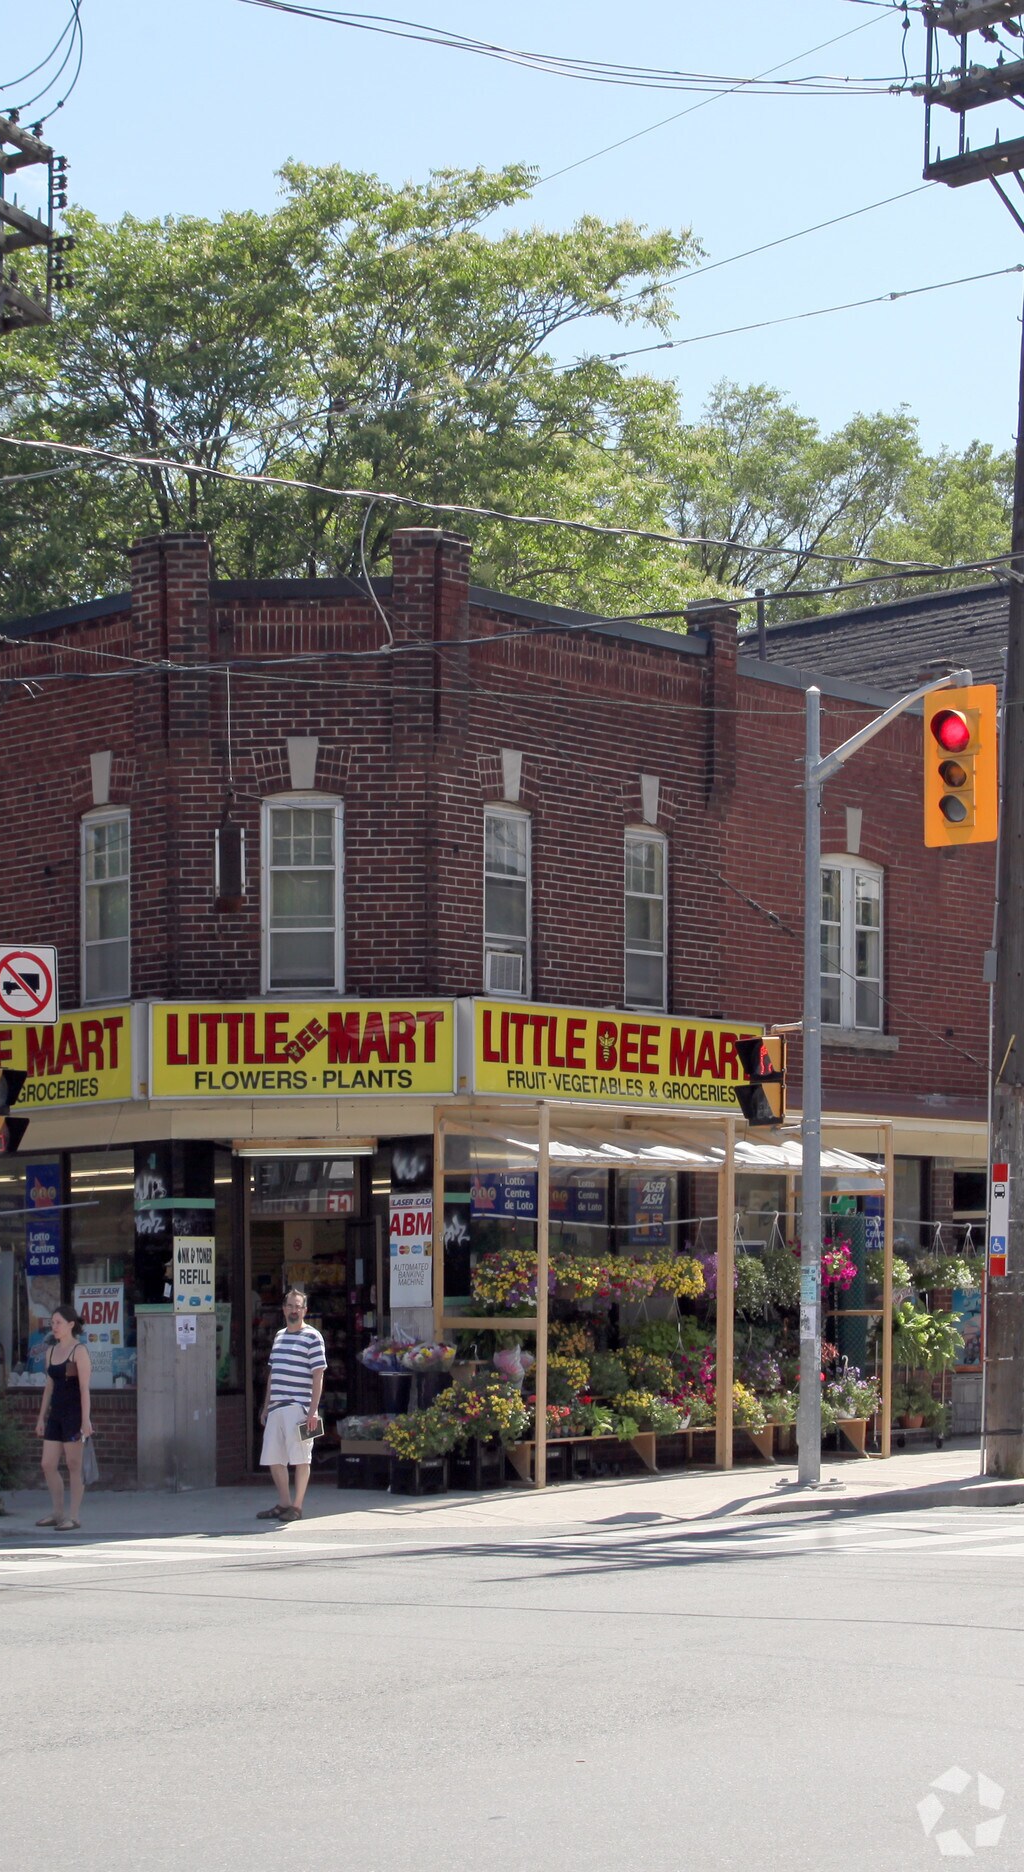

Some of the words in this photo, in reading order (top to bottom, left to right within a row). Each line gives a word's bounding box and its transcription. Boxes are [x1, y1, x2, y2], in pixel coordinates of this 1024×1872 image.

[166, 1012, 290, 1066] LITTLE
[282, 1017, 329, 1064] BEE
[327, 1011, 444, 1064] MART
[483, 1010, 587, 1070] LITTLE
[596, 1021, 661, 1075] BEE
[27, 1016, 124, 1078] MART
[194, 1070, 307, 1089] FLOWERS
[322, 1069, 413, 1089] PLANTS
[18, 1078, 99, 1103] GROCERIES
[649, 1083, 659, 1098] &
[662, 1081, 737, 1104] GROCERIES
[505, 1176, 525, 1186] Lotto
[578, 1180, 595, 1188] Lotto
[504, 1188, 530, 1198] Centre
[578, 1191, 599, 1200] Centre
[505, 1201, 514, 1210] de
[517, 1201, 534, 1210] Loto
[578, 1202, 586, 1211] de
[588, 1202, 602, 1211] Loto
[389, 1212, 433, 1237] ABM
[29, 1232, 50, 1242] Lotto
[29, 1244, 55, 1254] Centre
[30, 1256, 39, 1266] de
[41, 1256, 59, 1265] Loto
[196, 1247, 213, 1265] TONER
[393, 1263, 429, 1272] AUTOMATED
[179, 1269, 211, 1285] REFILL
[398, 1270, 425, 1279] BANKING
[398, 1277, 425, 1286] MACHINE
[81, 1301, 120, 1325] ABM
